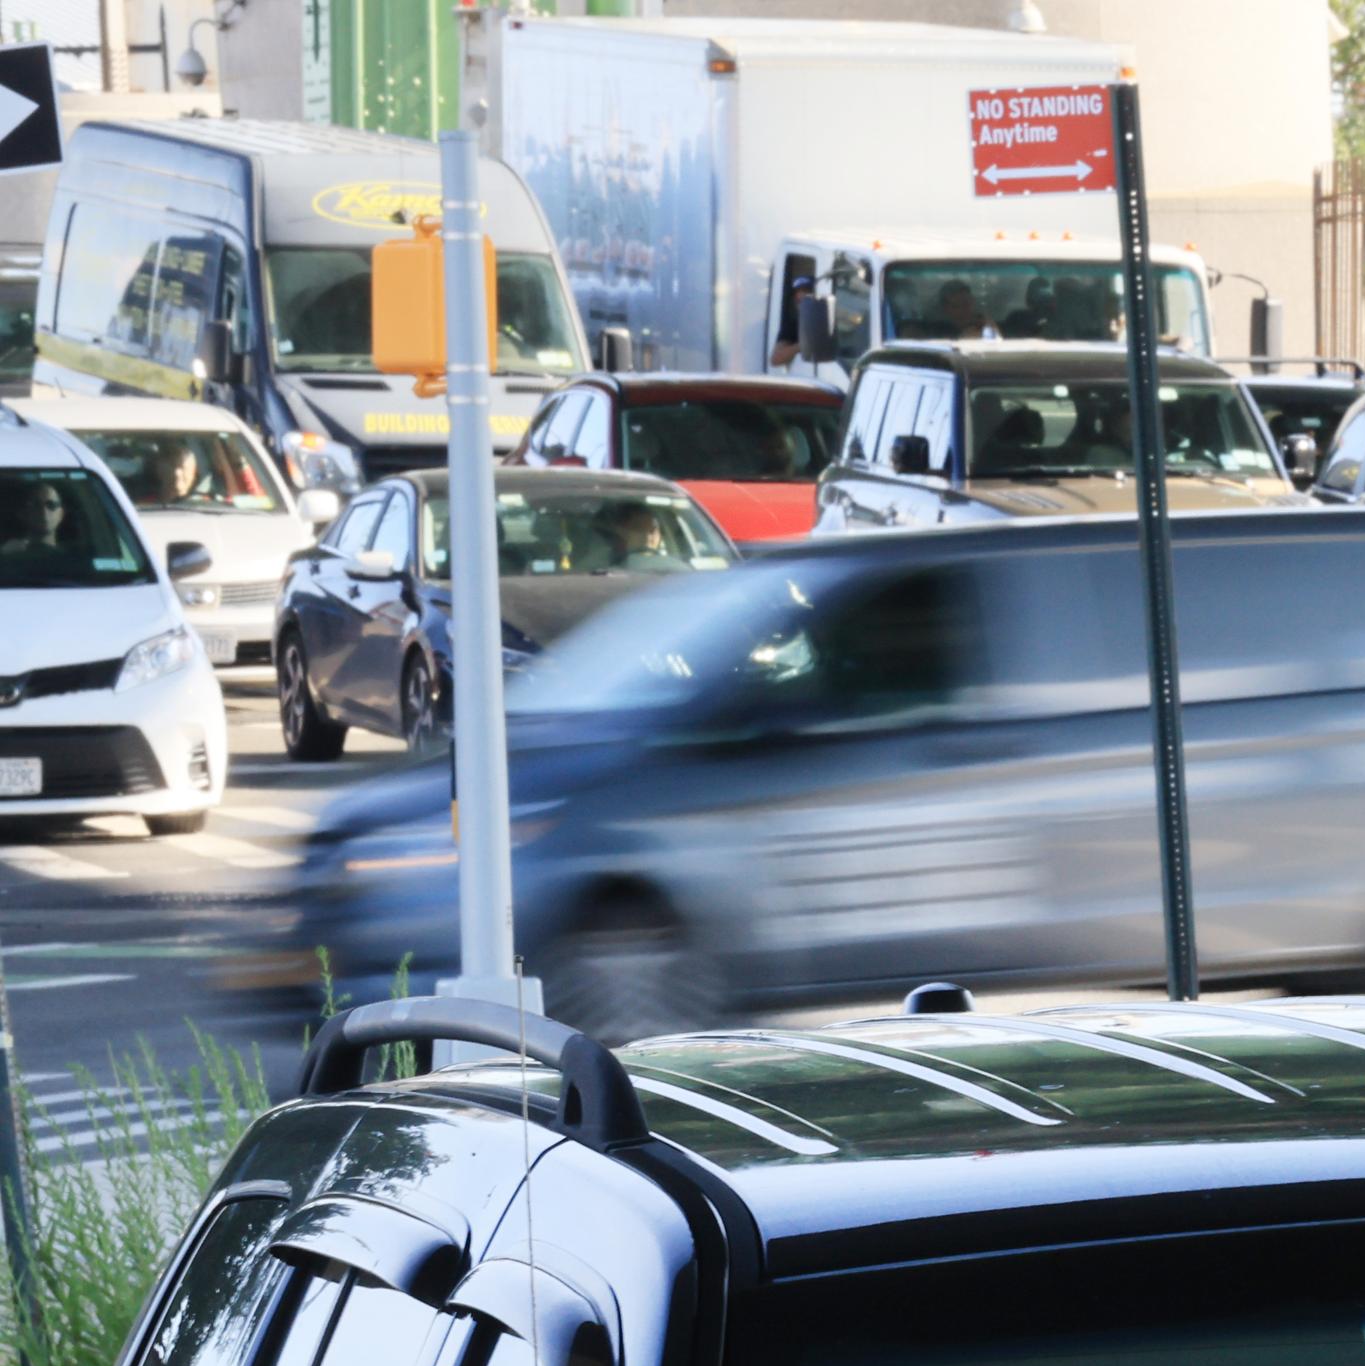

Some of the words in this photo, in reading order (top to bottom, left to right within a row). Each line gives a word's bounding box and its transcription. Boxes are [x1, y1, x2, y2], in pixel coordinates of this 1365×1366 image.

[976, 97, 1005, 119] NO
[1007, 93, 1103, 118] STANDING
[979, 121, 1058, 148] Anytime
